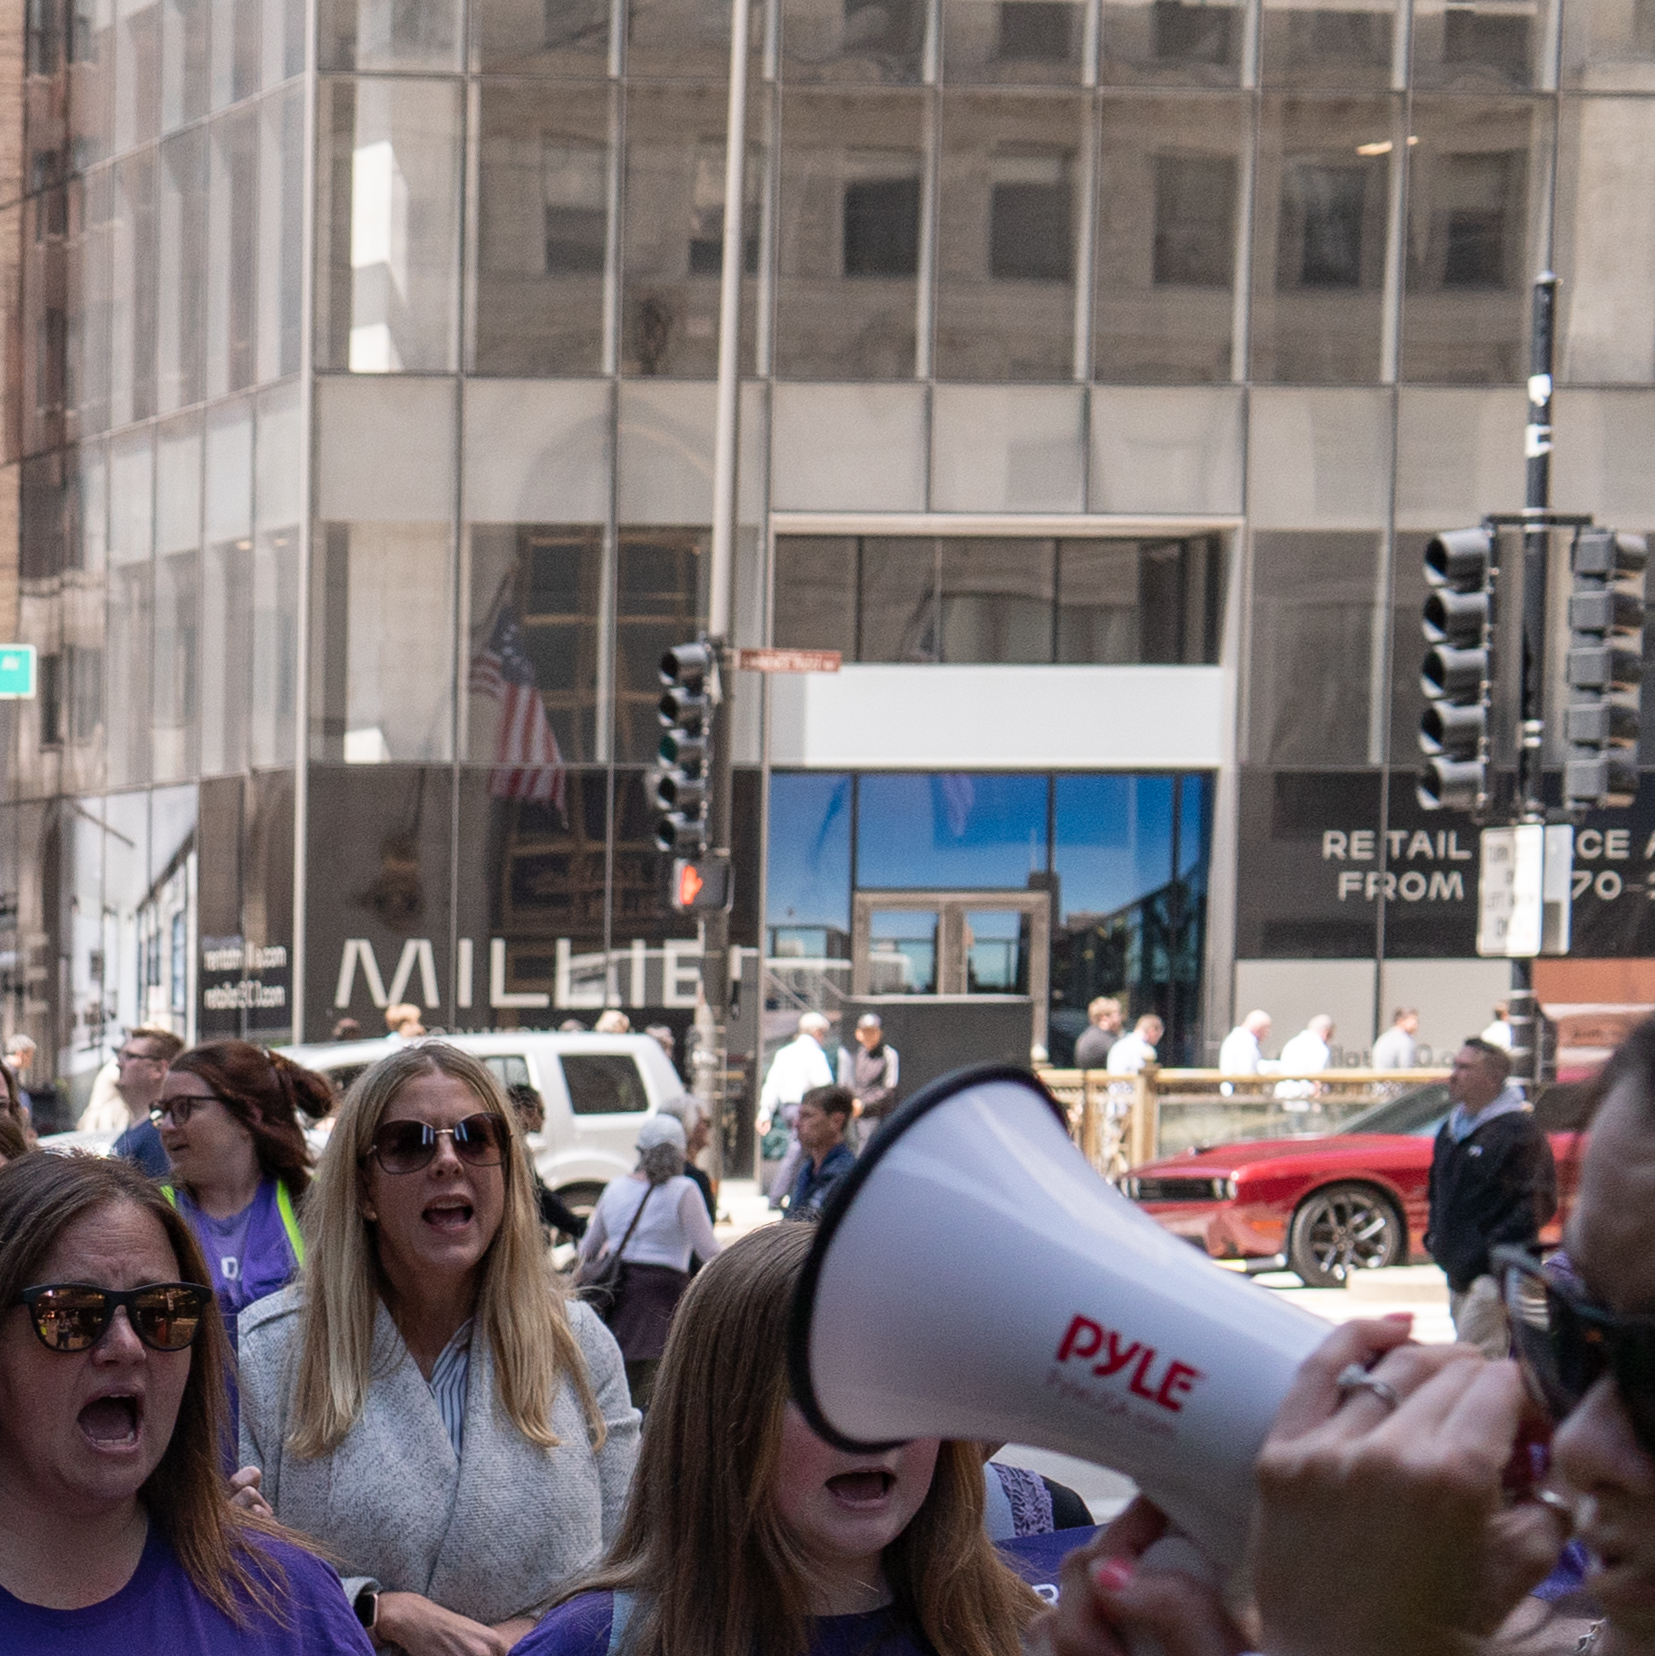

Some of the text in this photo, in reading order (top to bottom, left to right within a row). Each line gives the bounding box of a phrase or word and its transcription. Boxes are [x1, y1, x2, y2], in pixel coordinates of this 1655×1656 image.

[1321, 829, 1473, 861] RETAIL
[1339, 870, 1465, 901] FROM
[335, 938, 705, 1009] MILLIE
